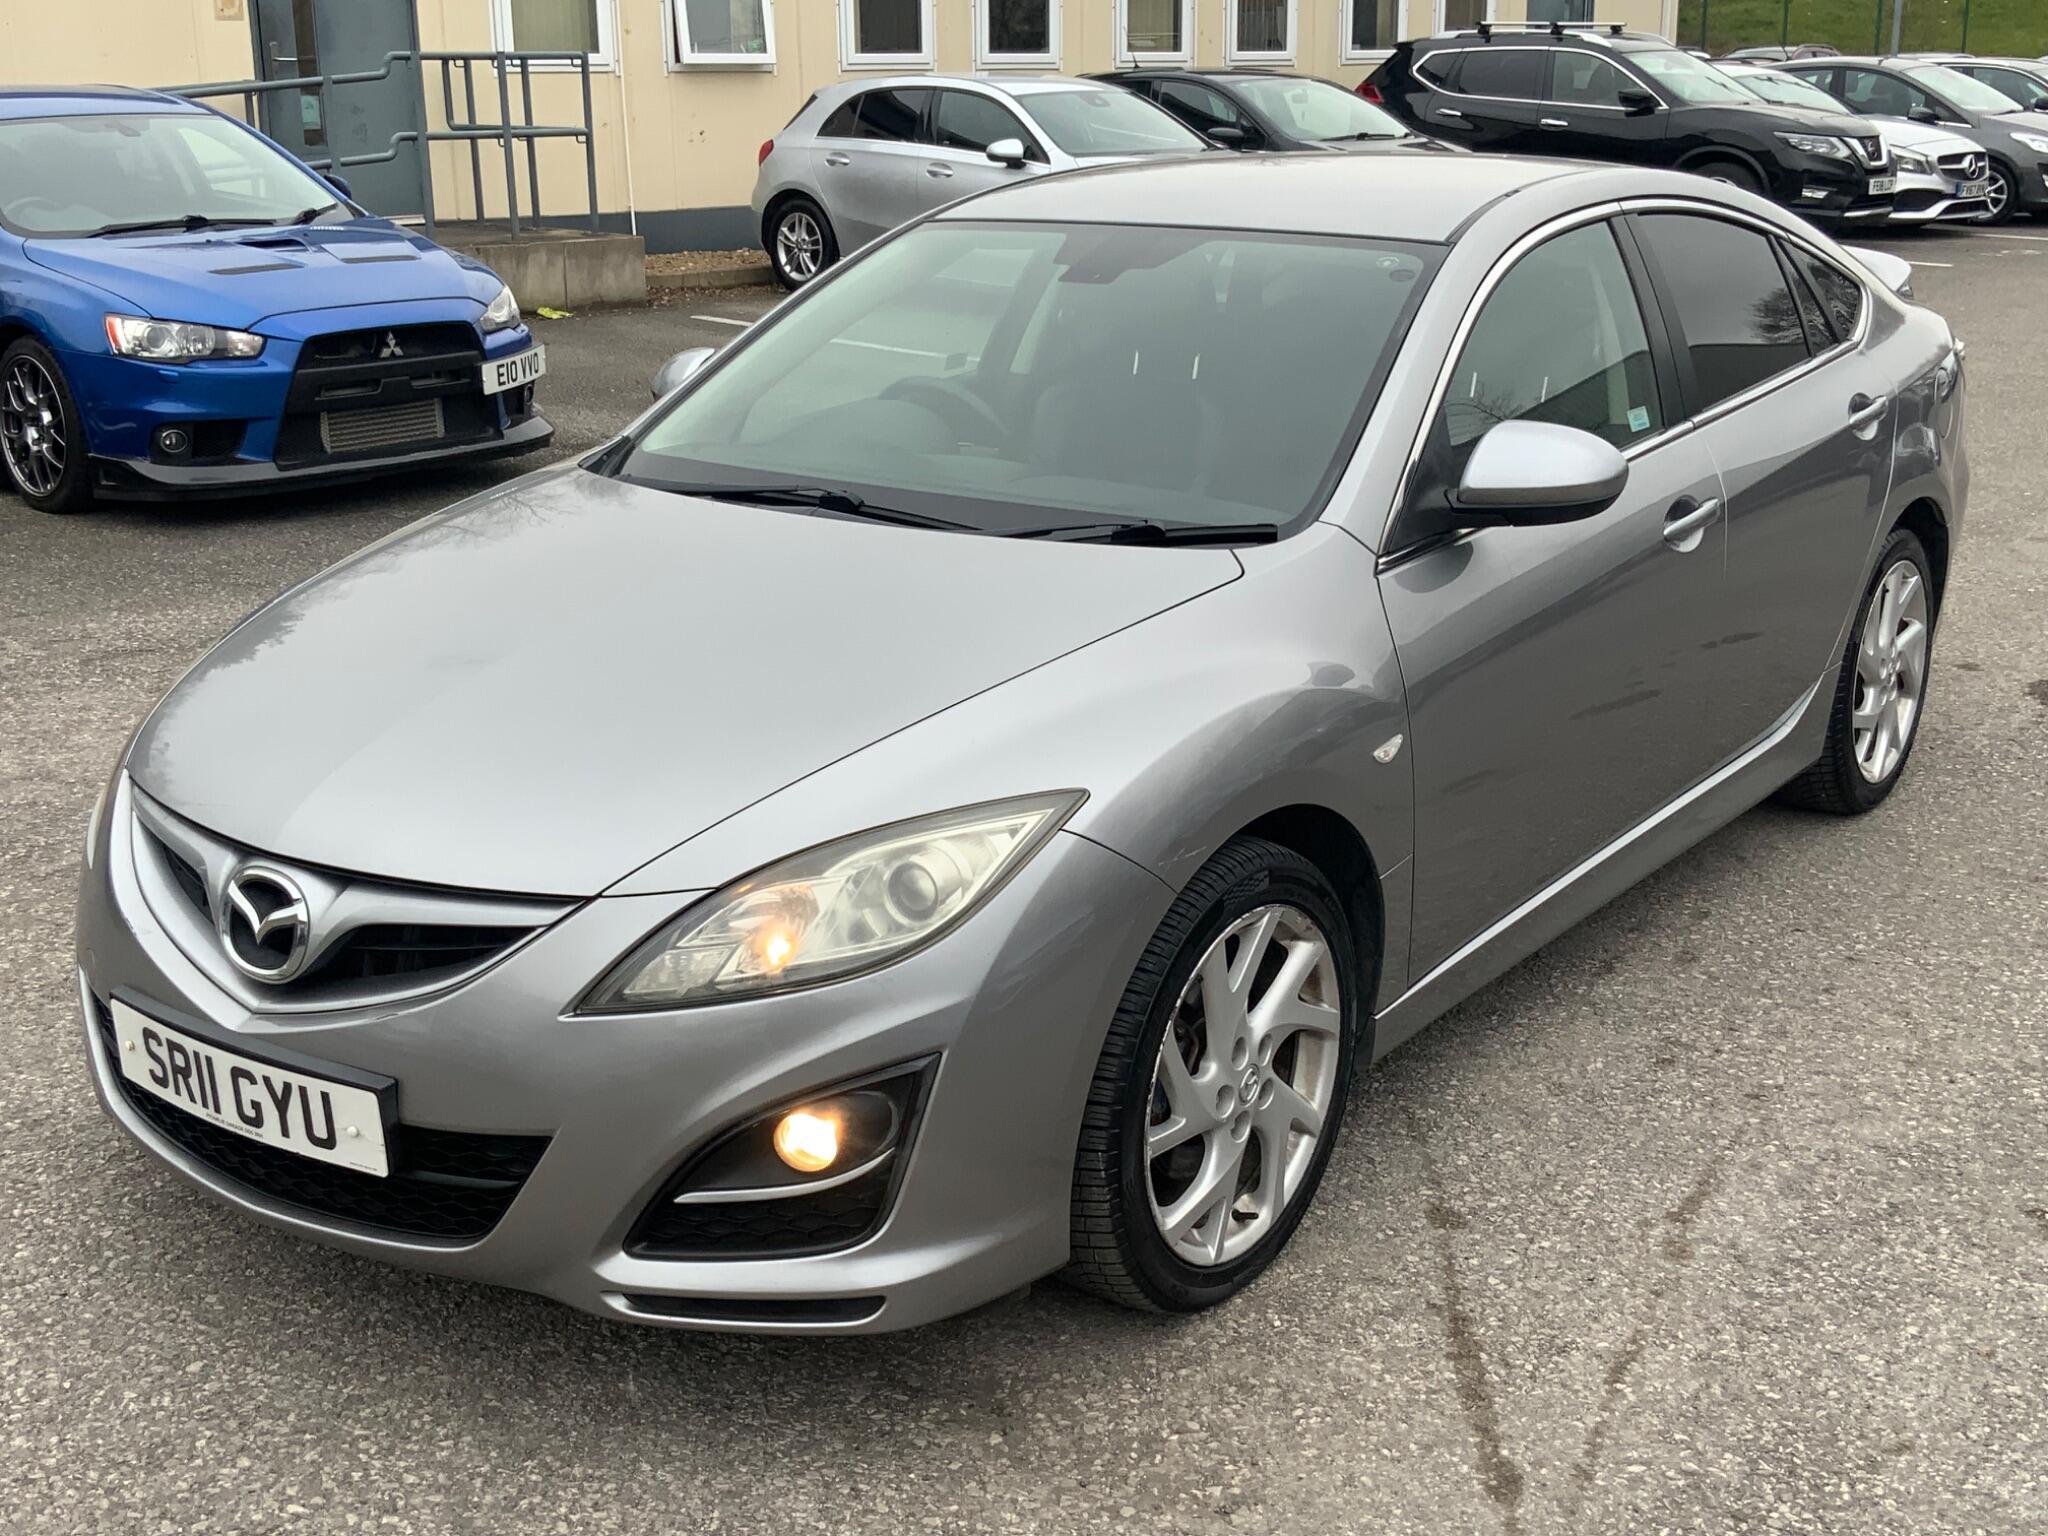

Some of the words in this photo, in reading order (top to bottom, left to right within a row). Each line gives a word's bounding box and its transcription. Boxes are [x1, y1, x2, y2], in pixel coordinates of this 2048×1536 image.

[496, 360, 518, 387] E10
[142, 1026, 222, 1115] SR11
[230, 1065, 337, 1151] GYU
